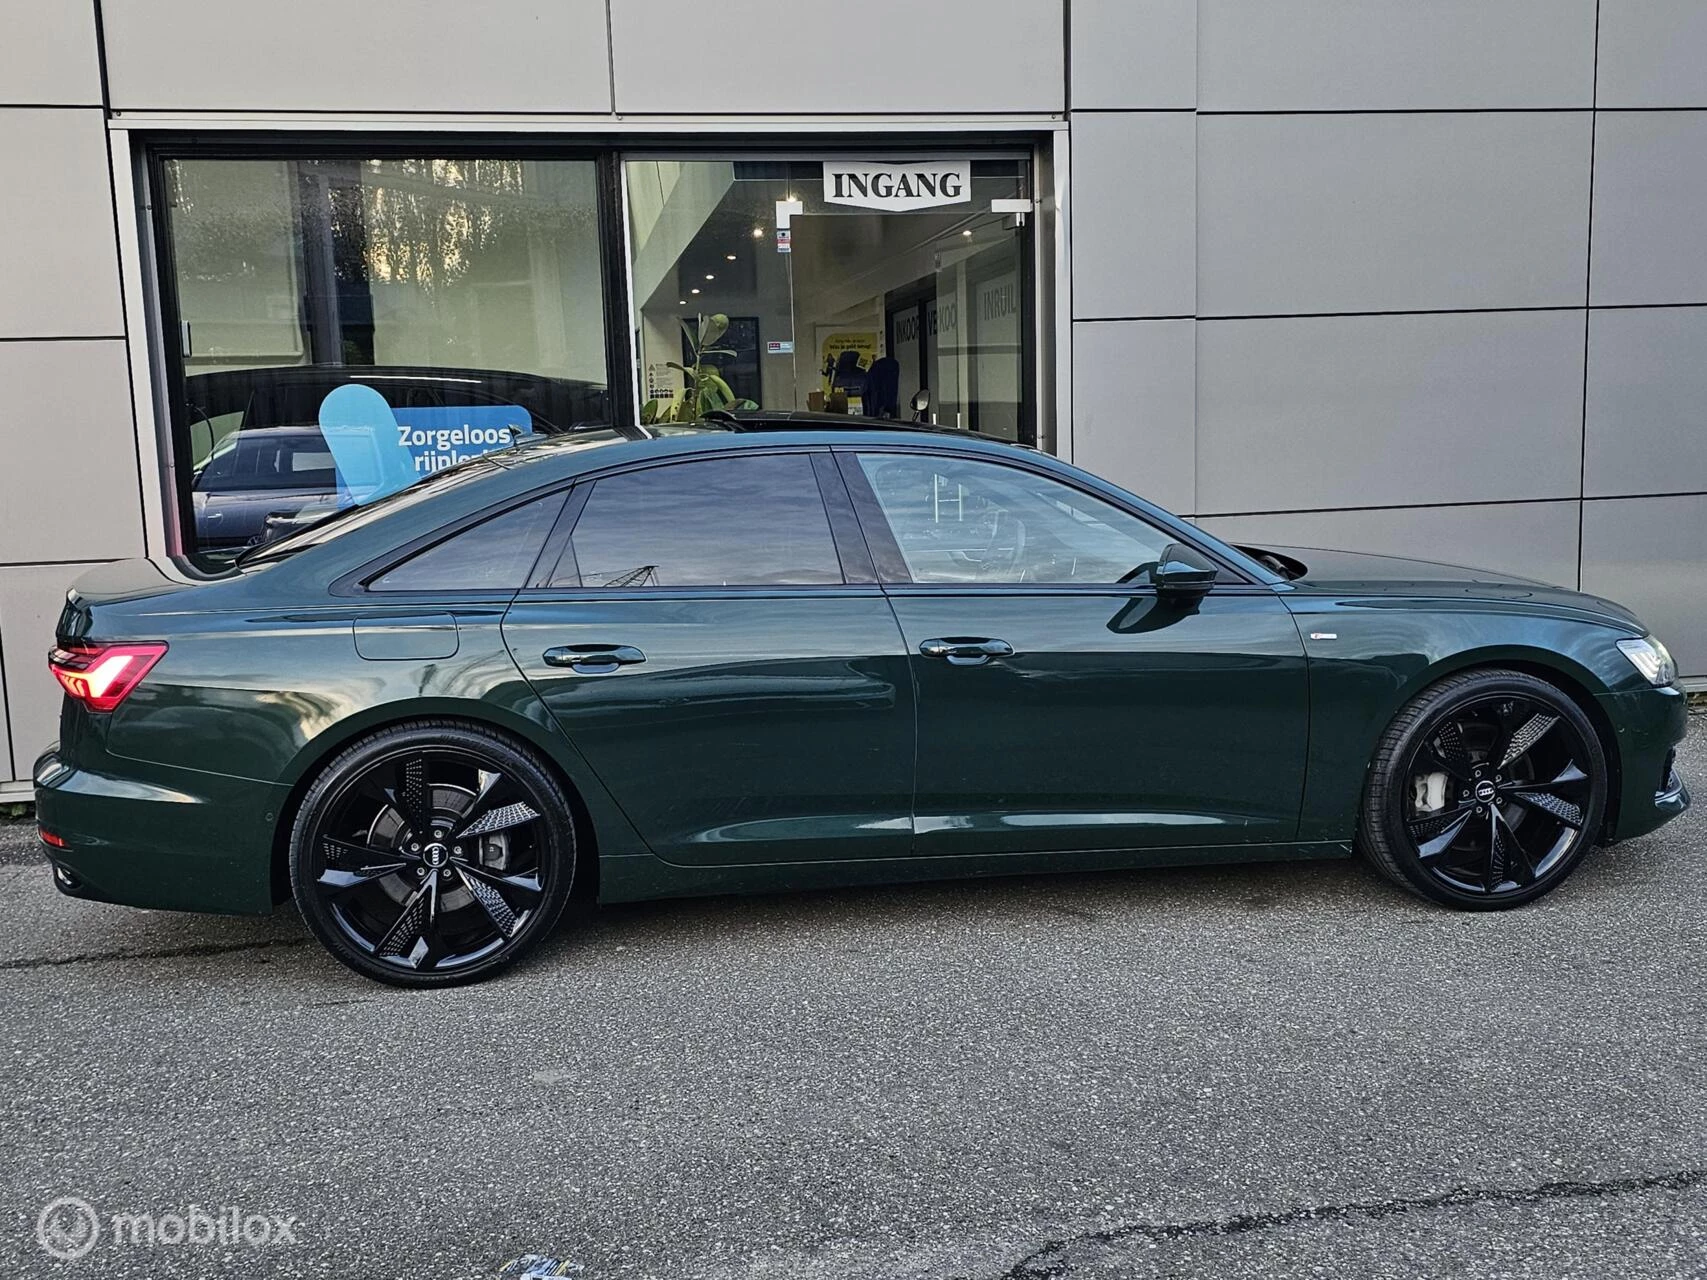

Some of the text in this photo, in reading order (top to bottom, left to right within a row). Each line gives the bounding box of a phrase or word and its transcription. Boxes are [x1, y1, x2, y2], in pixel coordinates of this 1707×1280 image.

[832, 172, 962, 198] INGANG
[984, 282, 1017, 321] INRUIL
[397, 423, 511, 451] Zorgeloos
